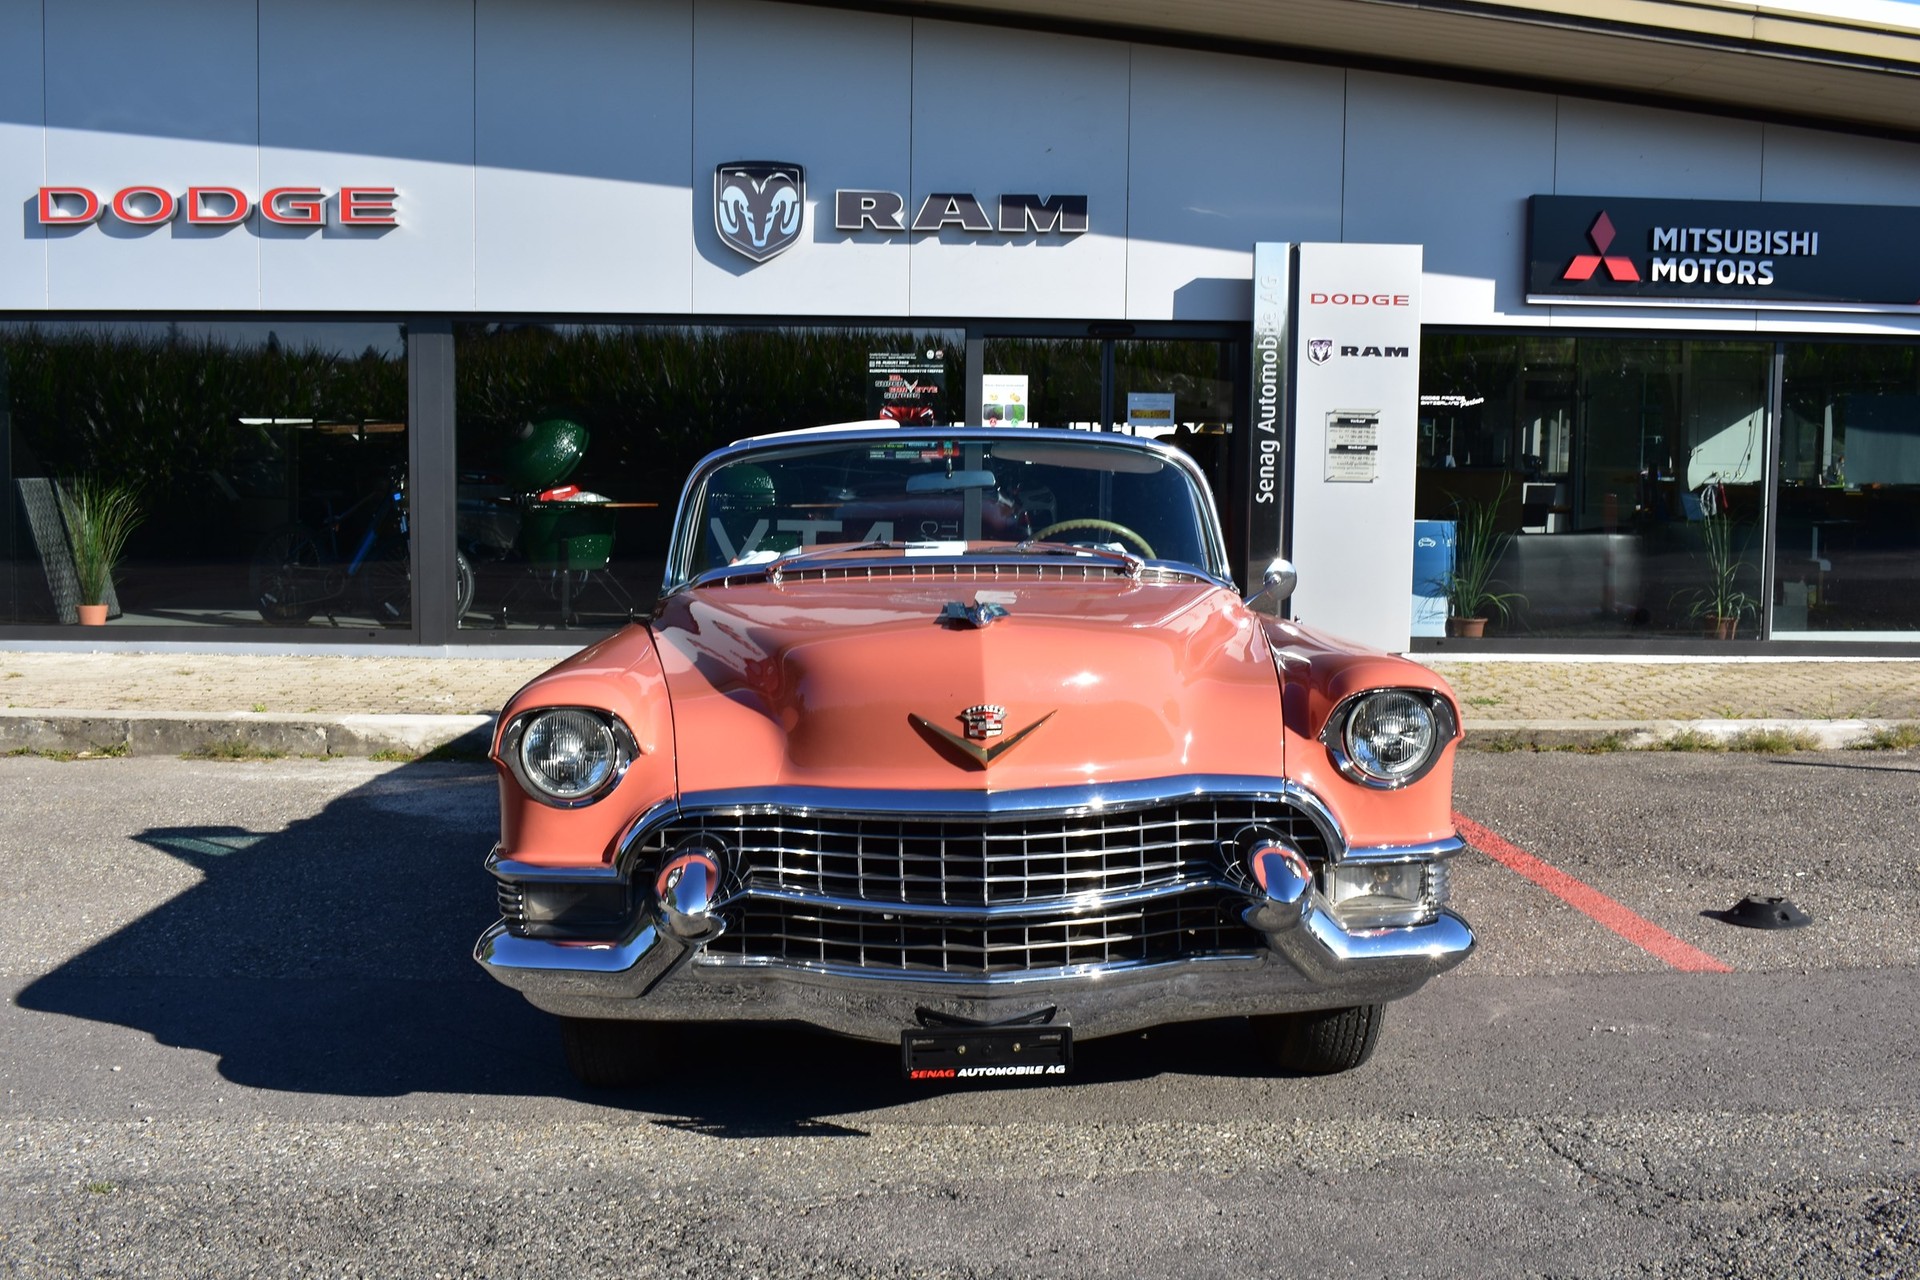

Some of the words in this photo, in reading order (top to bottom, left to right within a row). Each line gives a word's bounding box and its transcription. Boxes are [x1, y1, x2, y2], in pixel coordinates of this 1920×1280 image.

[37, 185, 401, 227] DODGE
[834, 188, 1090, 234] RAM
[1652, 226, 1819, 257] MITSUBISHI
[1651, 257, 1774, 286] MOTORS
[1310, 293, 1410, 306] DODGE
[1340, 345, 1410, 358] RAM
[1256, 439, 1281, 504] Senag
[910, 1069, 956, 1080] SENAG
[957, 1066, 1043, 1078] AUTOMOBILE
[1045, 1065, 1066, 1075] AG
